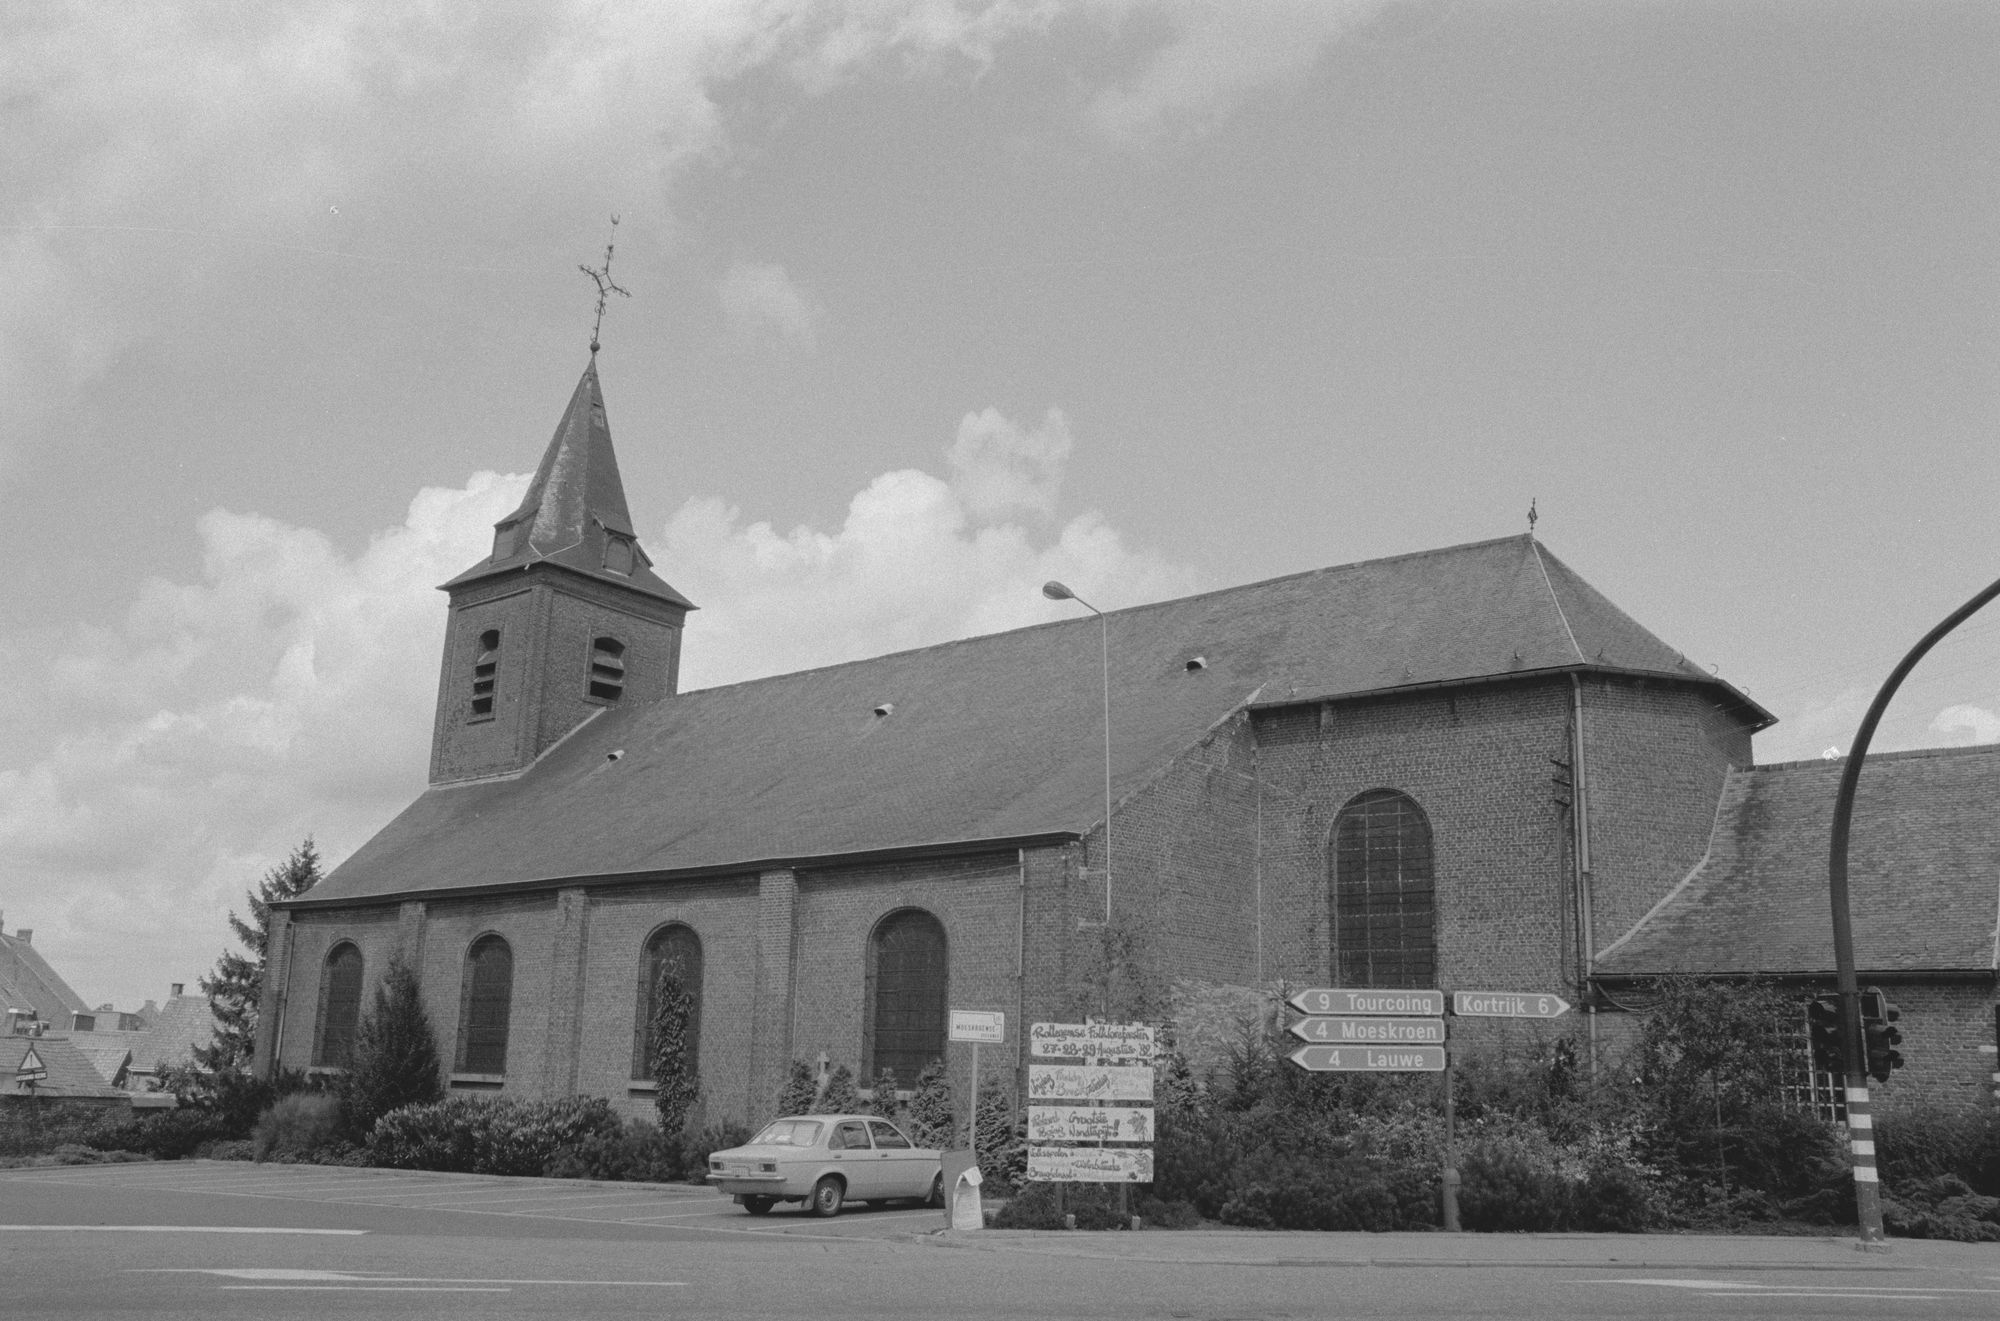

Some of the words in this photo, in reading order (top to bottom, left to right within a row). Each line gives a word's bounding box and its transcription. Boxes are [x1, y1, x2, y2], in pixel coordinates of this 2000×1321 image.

[1318, 994, 1330, 1010] 9
[1347, 993, 1432, 1014] Tourcoing
[1463, 996, 1526, 1017] Kortrijk
[1538, 998, 1549, 1014] 6
[1316, 1022, 1328, 1038] 4
[1342, 1022, 1437, 1040] Moeskroen
[1329, 1051, 1340, 1067] 4
[1367, 1051, 1423, 1067] Lauwe
